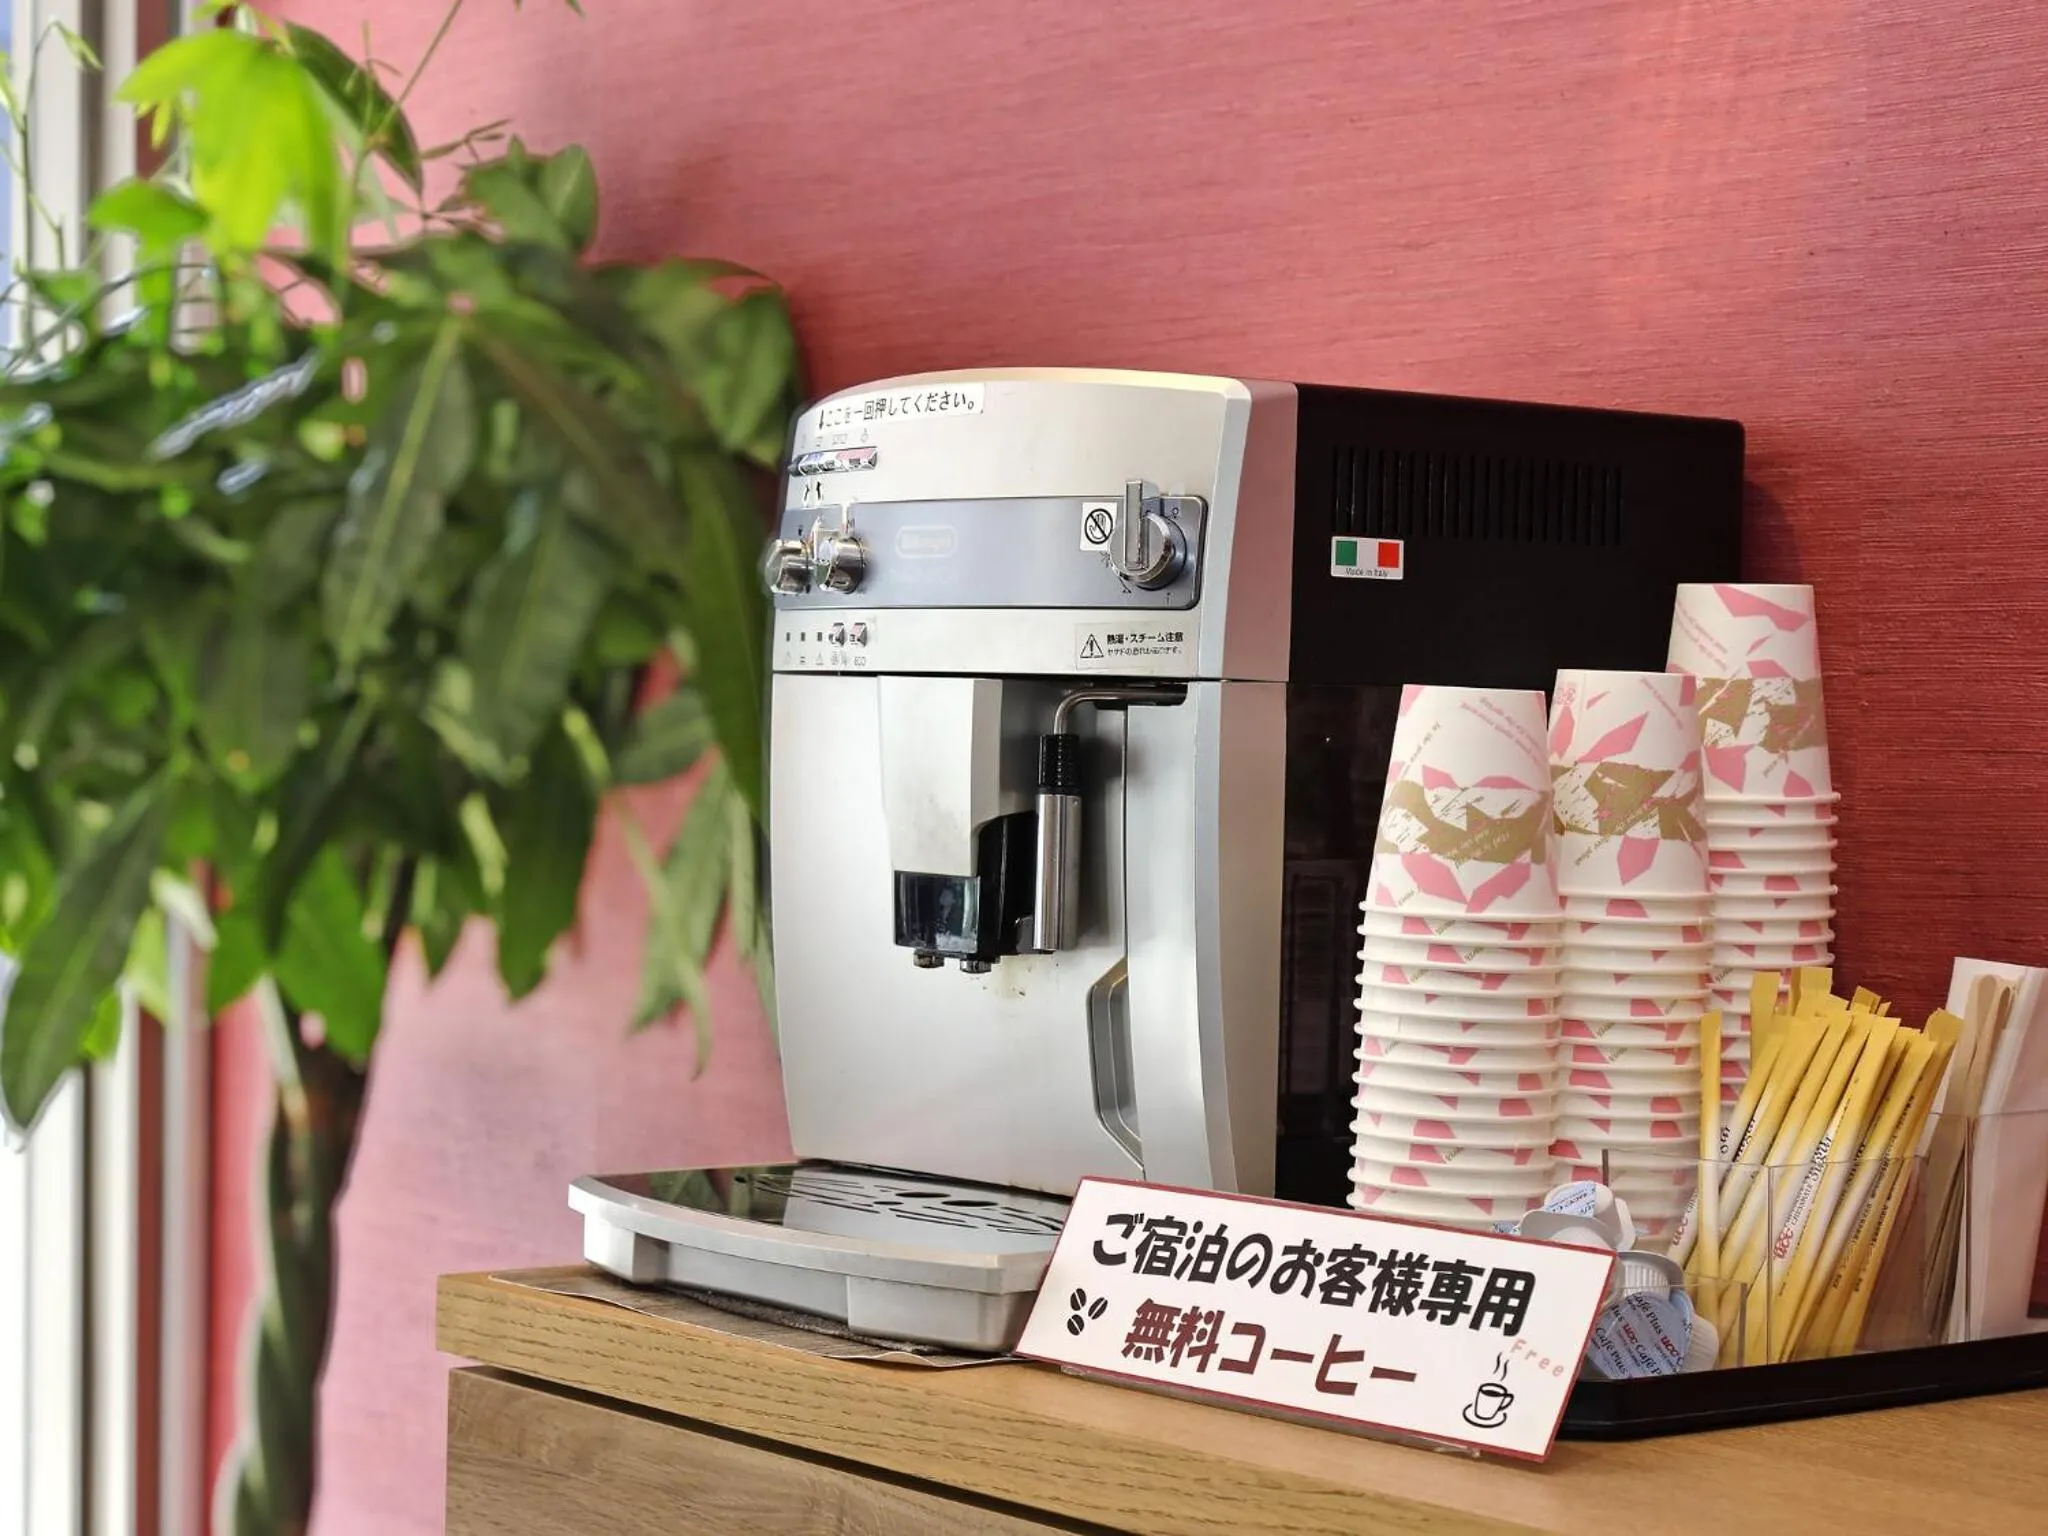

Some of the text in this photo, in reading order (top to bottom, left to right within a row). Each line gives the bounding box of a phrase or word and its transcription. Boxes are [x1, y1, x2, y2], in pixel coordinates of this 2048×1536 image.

[1093, 1213, 1536, 1337] ご宿泊のお客様専用
[1121, 1298, 1418, 1396] 無料コーヒー
[1595, 1327, 1617, 1352] Café
[1611, 1348, 1629, 1375] Plus
[1611, 1304, 1624, 1322] lus
[1635, 1344, 1656, 1368] Café
[1646, 1312, 1664, 1336] Plus
[1510, 1339, 1564, 1377] Free
